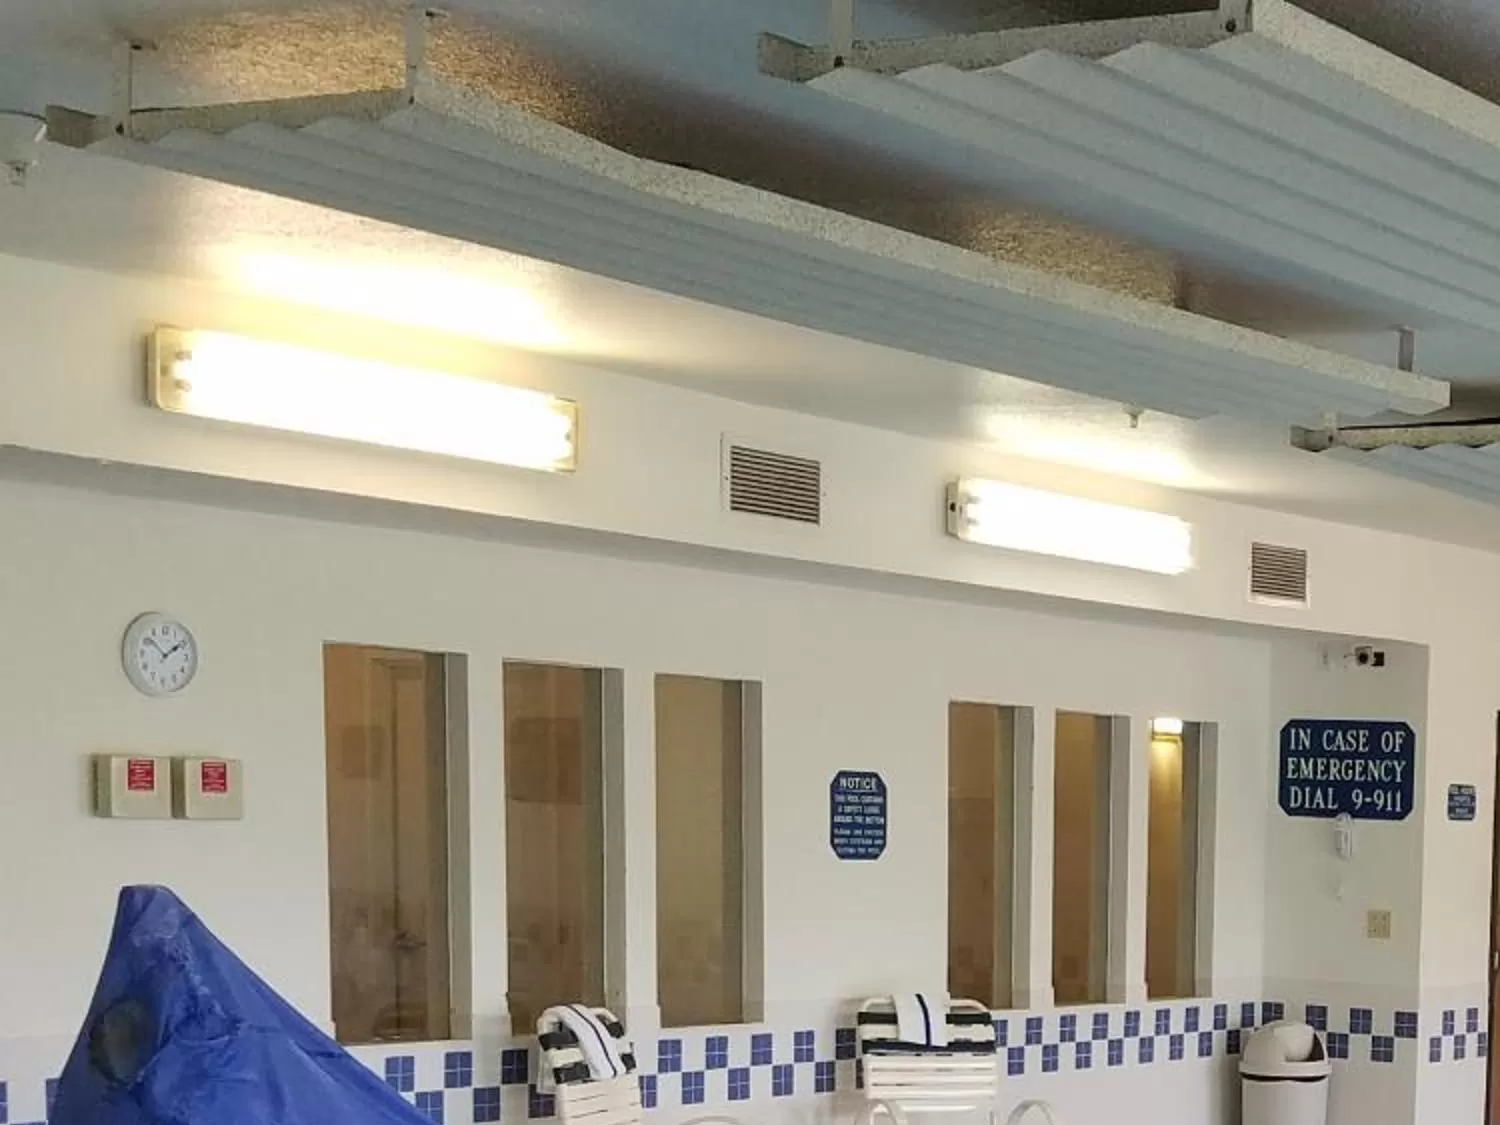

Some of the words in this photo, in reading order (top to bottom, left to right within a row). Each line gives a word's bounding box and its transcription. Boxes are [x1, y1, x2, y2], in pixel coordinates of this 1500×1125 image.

[1289, 727, 1312, 750] IN
[1322, 729, 1369, 751] CASE
[1381, 731, 1406, 753] OF
[1286, 757, 1407, 782] EMERGENCY
[839, 777, 878, 790] NOTICE
[1289, 786, 1338, 809] DIAL
[1351, 789, 1402, 812] 9-911
